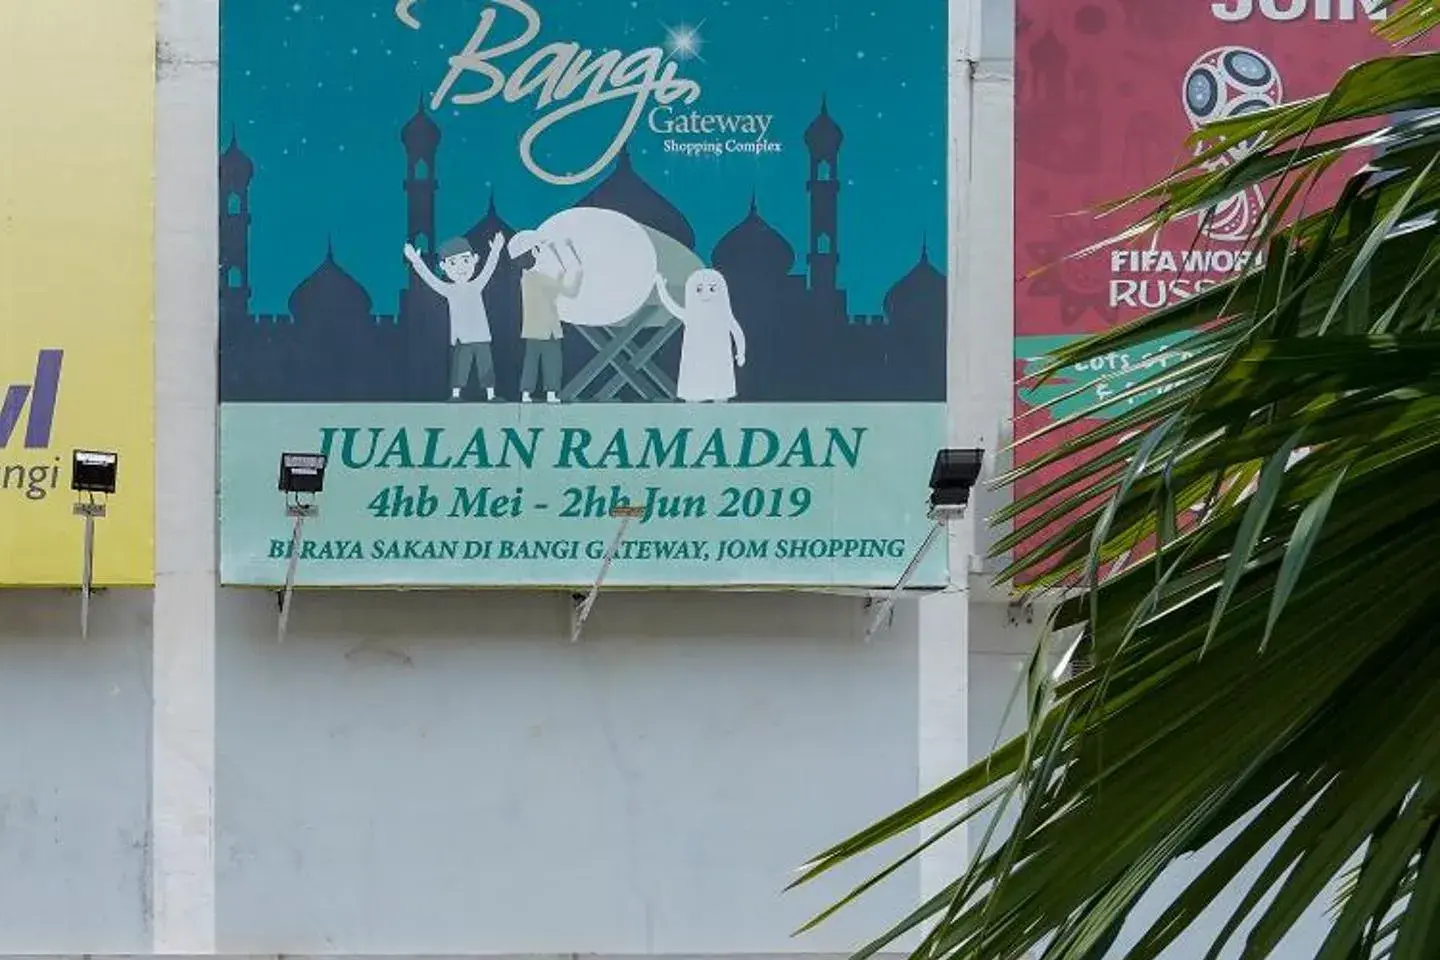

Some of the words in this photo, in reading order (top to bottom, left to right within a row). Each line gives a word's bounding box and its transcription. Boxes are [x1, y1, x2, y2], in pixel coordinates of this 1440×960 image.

[648, 106, 773, 139] Gateway
[663, 139, 723, 155] Shopping
[725, 139, 782, 154] Complex
[1111, 250, 1178, 272] FIFA
[318, 427, 545, 470] JUALAN
[554, 427, 869, 469] RAMADAN
[366, 485, 439, 518] 4hb
[447, 487, 524, 518] Mei
[639, 486, 708, 524] Jun
[717, 486, 812, 518] 2019
[371, 539, 460, 559] SAKAN
[461, 540, 493, 560] DI
[497, 539, 580, 560] BANGI
[716, 539, 769, 562] JOM
[774, 538, 906, 559] SHOPPING
